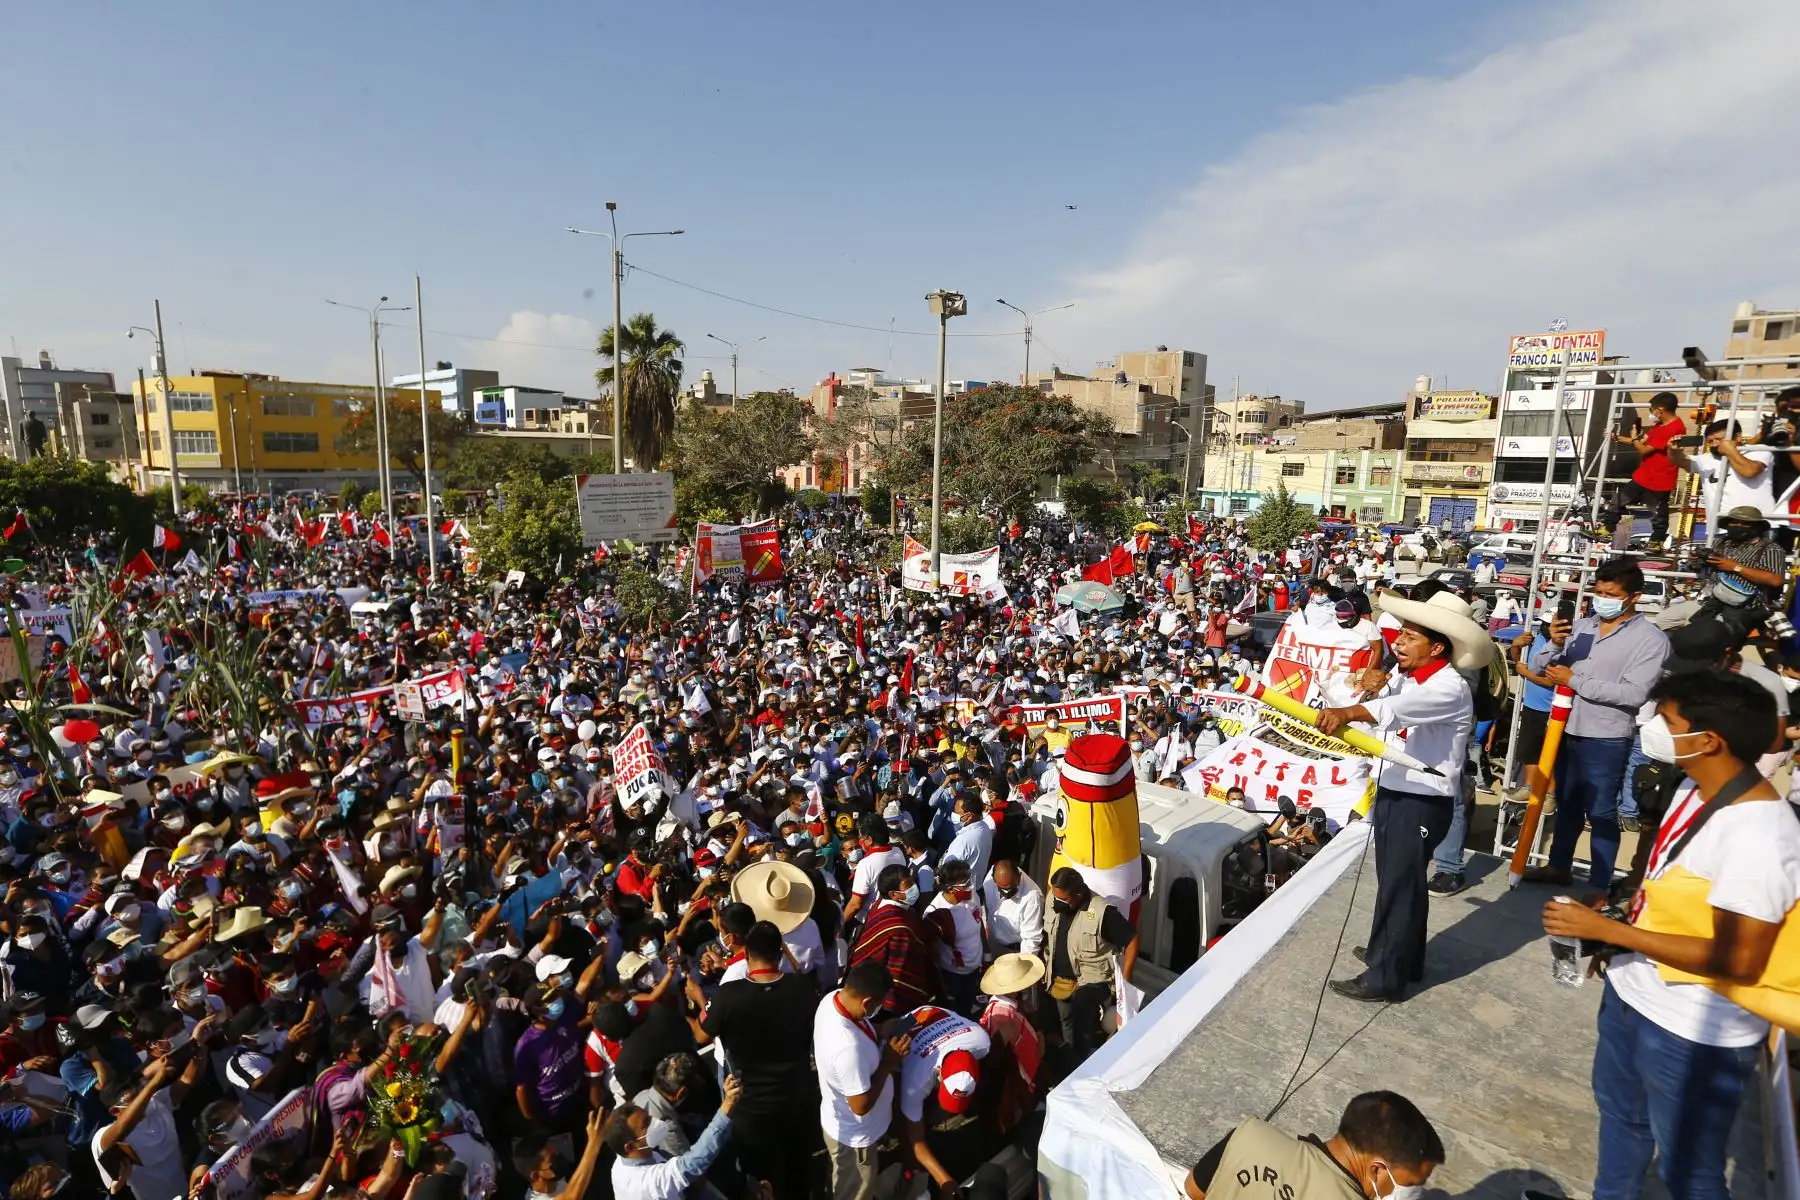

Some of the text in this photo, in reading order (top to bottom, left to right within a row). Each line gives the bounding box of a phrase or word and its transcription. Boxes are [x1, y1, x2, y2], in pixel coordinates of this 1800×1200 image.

[1553, 335, 1599, 350] DENTAL
[1510, 351, 1597, 366] FRANCO ALMANA
[1518, 395, 1530, 403] FA
[1508, 441, 1520, 449] FA
[715, 566, 741, 575] PEDRO
[612, 726, 645, 761] PEDRO
[1316, 738, 1333, 750] EN
[213, 1156, 240, 1184] PEDRO
[240, 1125, 271, 1161] CASTILLO
